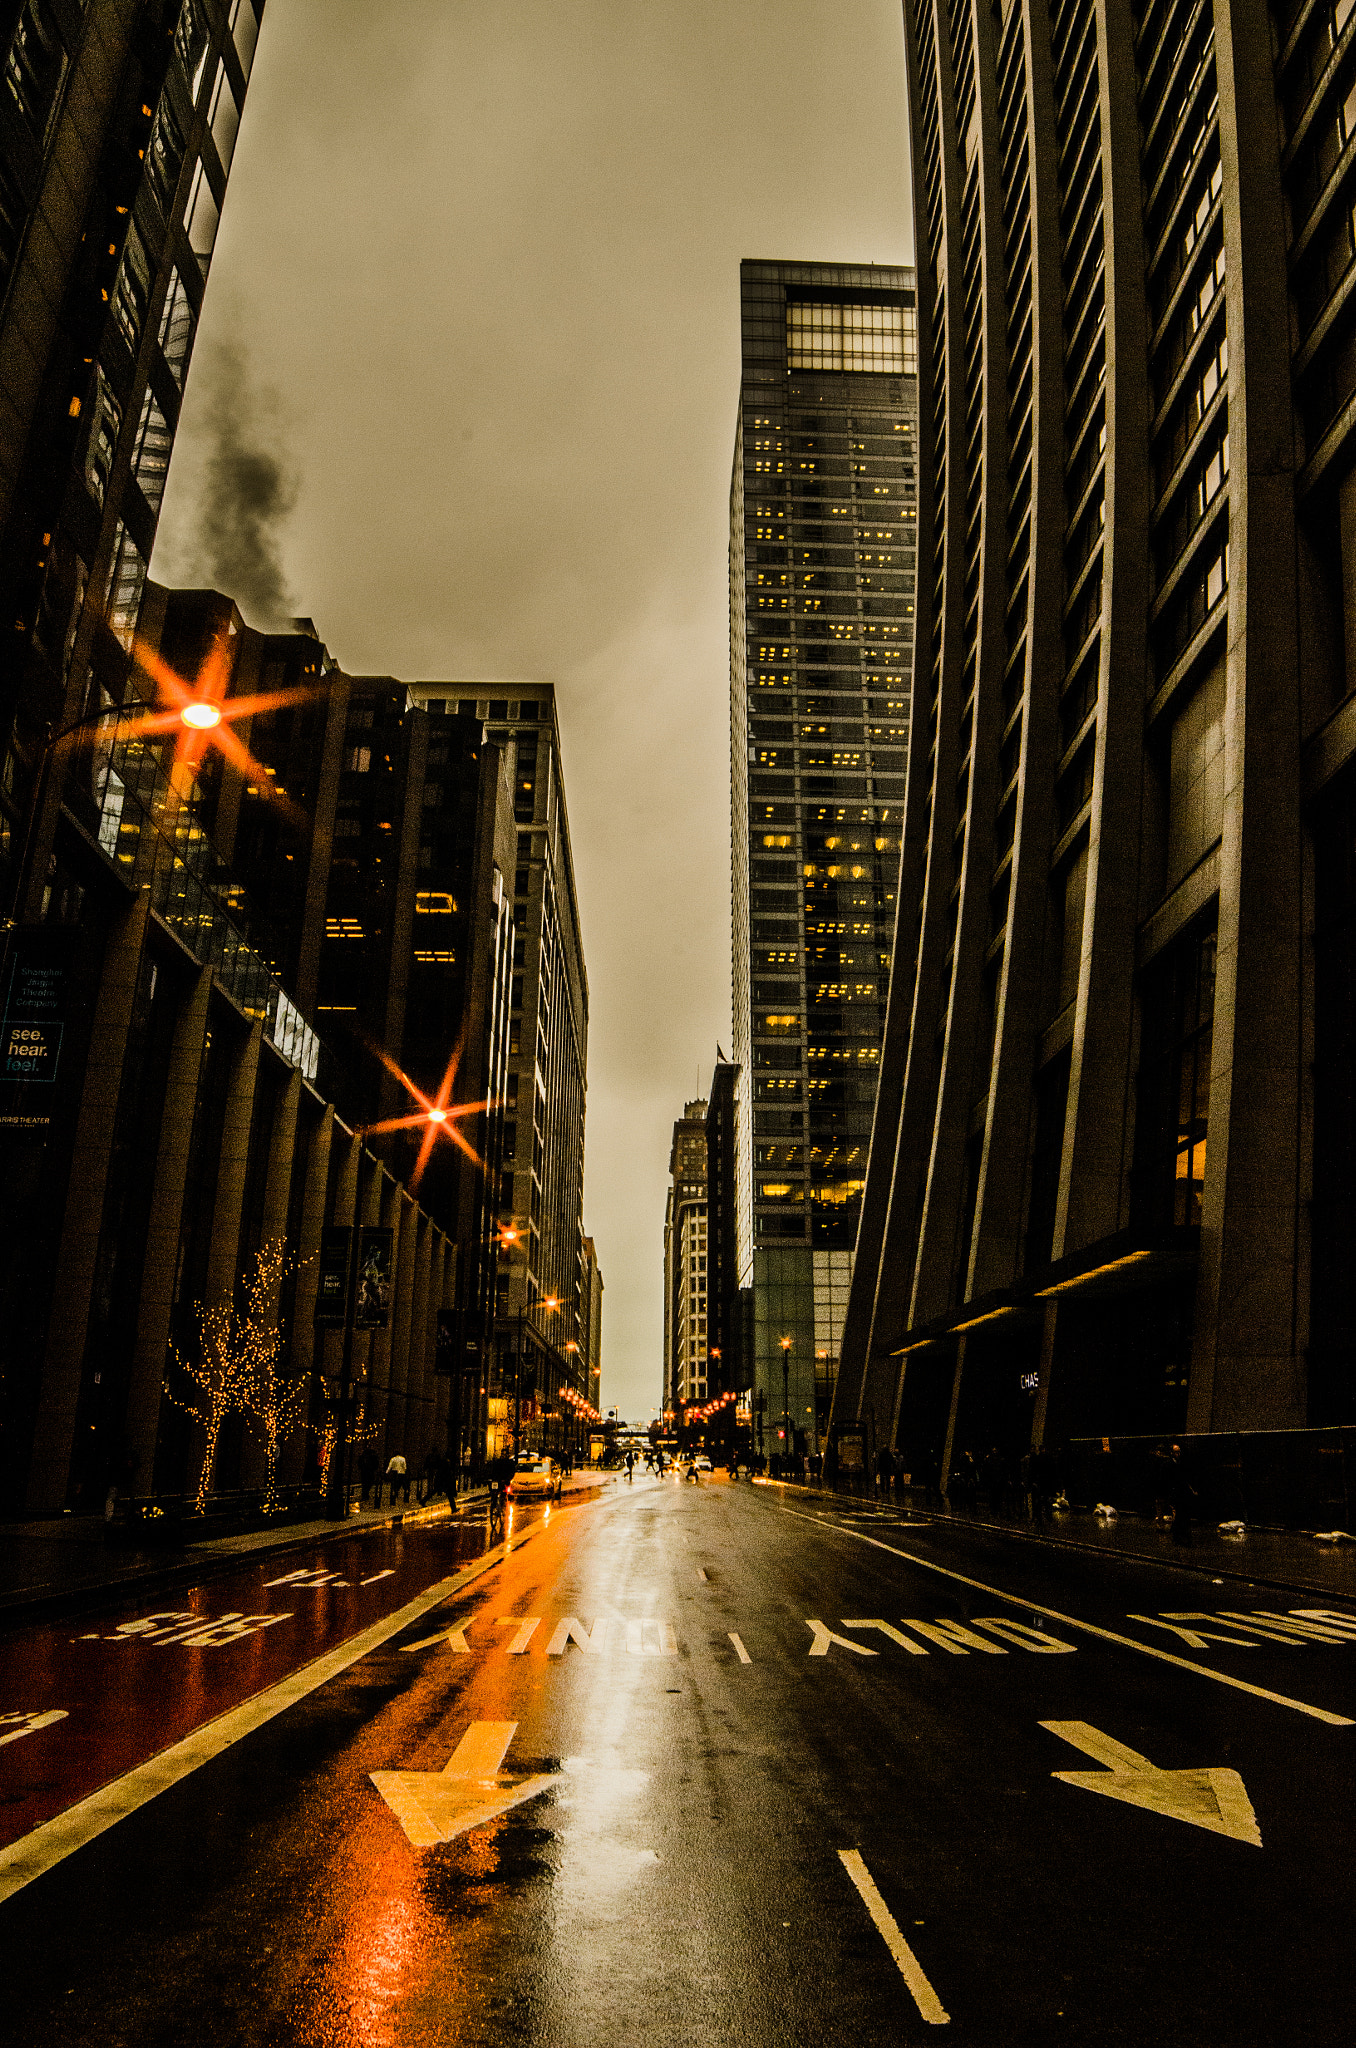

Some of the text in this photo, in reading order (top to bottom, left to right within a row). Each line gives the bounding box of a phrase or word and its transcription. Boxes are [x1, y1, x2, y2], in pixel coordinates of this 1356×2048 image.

[16, 998, 58, 1008] Company
[11, 1029, 45, 1041] see.
[8, 1041, 48, 1057] hear.
[5, 1057, 40, 1072] feel.
[20, 1116, 50, 1124] THEATER
[398, 1616, 679, 1655] ONLY
[805, 1618, 1078, 1656] ONLY
